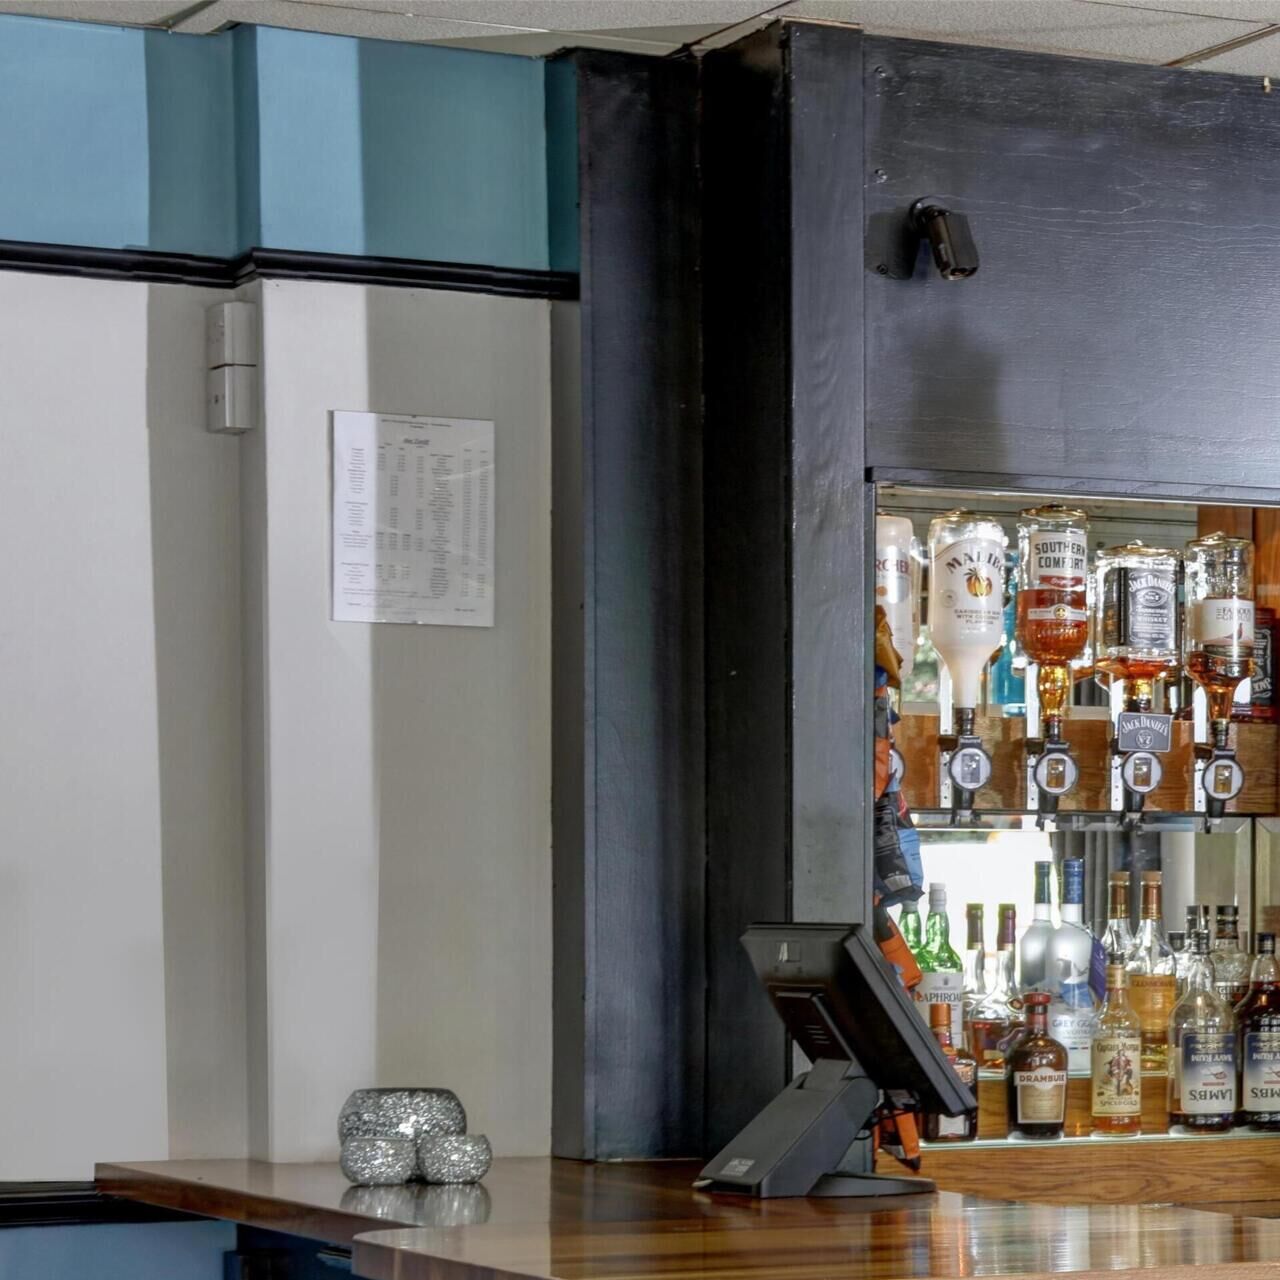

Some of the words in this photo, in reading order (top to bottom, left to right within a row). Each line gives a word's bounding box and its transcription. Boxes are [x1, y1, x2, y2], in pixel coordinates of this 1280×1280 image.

[1035, 541, 1086, 557] SOUTHERN
[1019, 1074, 1065, 1083] DRAMBUIE
[1189, 1088, 1233, 1101] LAMB'S
